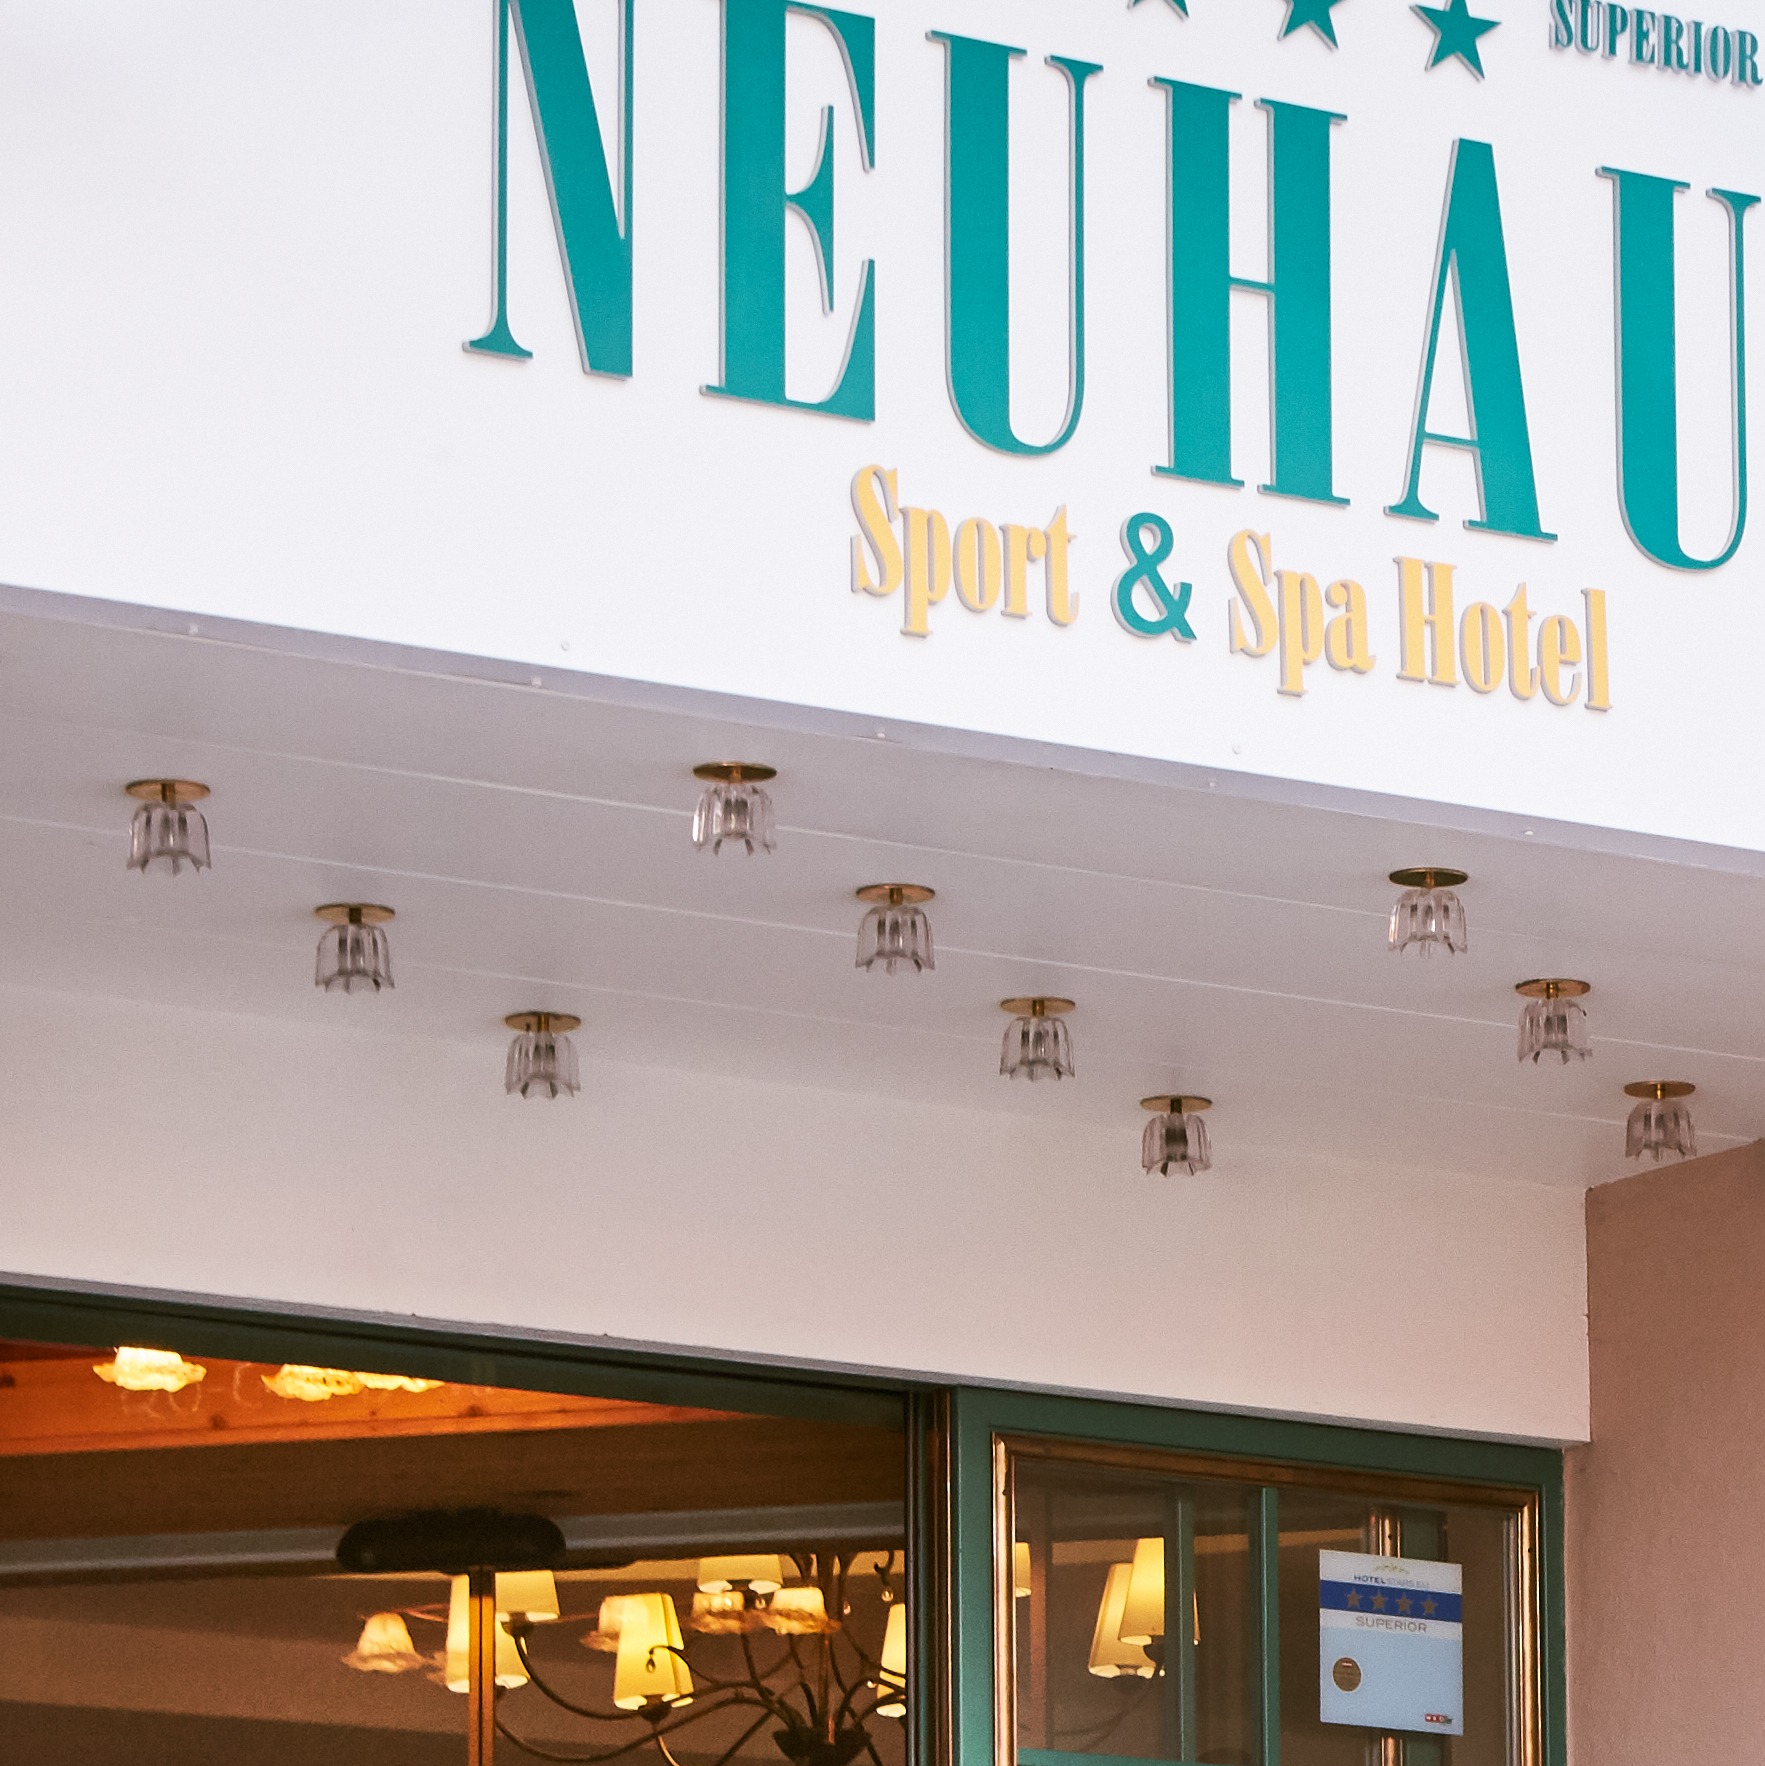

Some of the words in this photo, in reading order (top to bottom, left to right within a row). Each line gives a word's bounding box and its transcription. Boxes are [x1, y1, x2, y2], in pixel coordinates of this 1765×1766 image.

[1549, 0, 1763, 88] SUPERIOR
[850, 464, 1081, 638] Sport
[1111, 511, 1198, 644] &
[1227, 527, 1377, 698] Spa
[1392, 555, 1613, 712] Hotel
[1355, 1615, 1428, 1633] SUPERIOR
